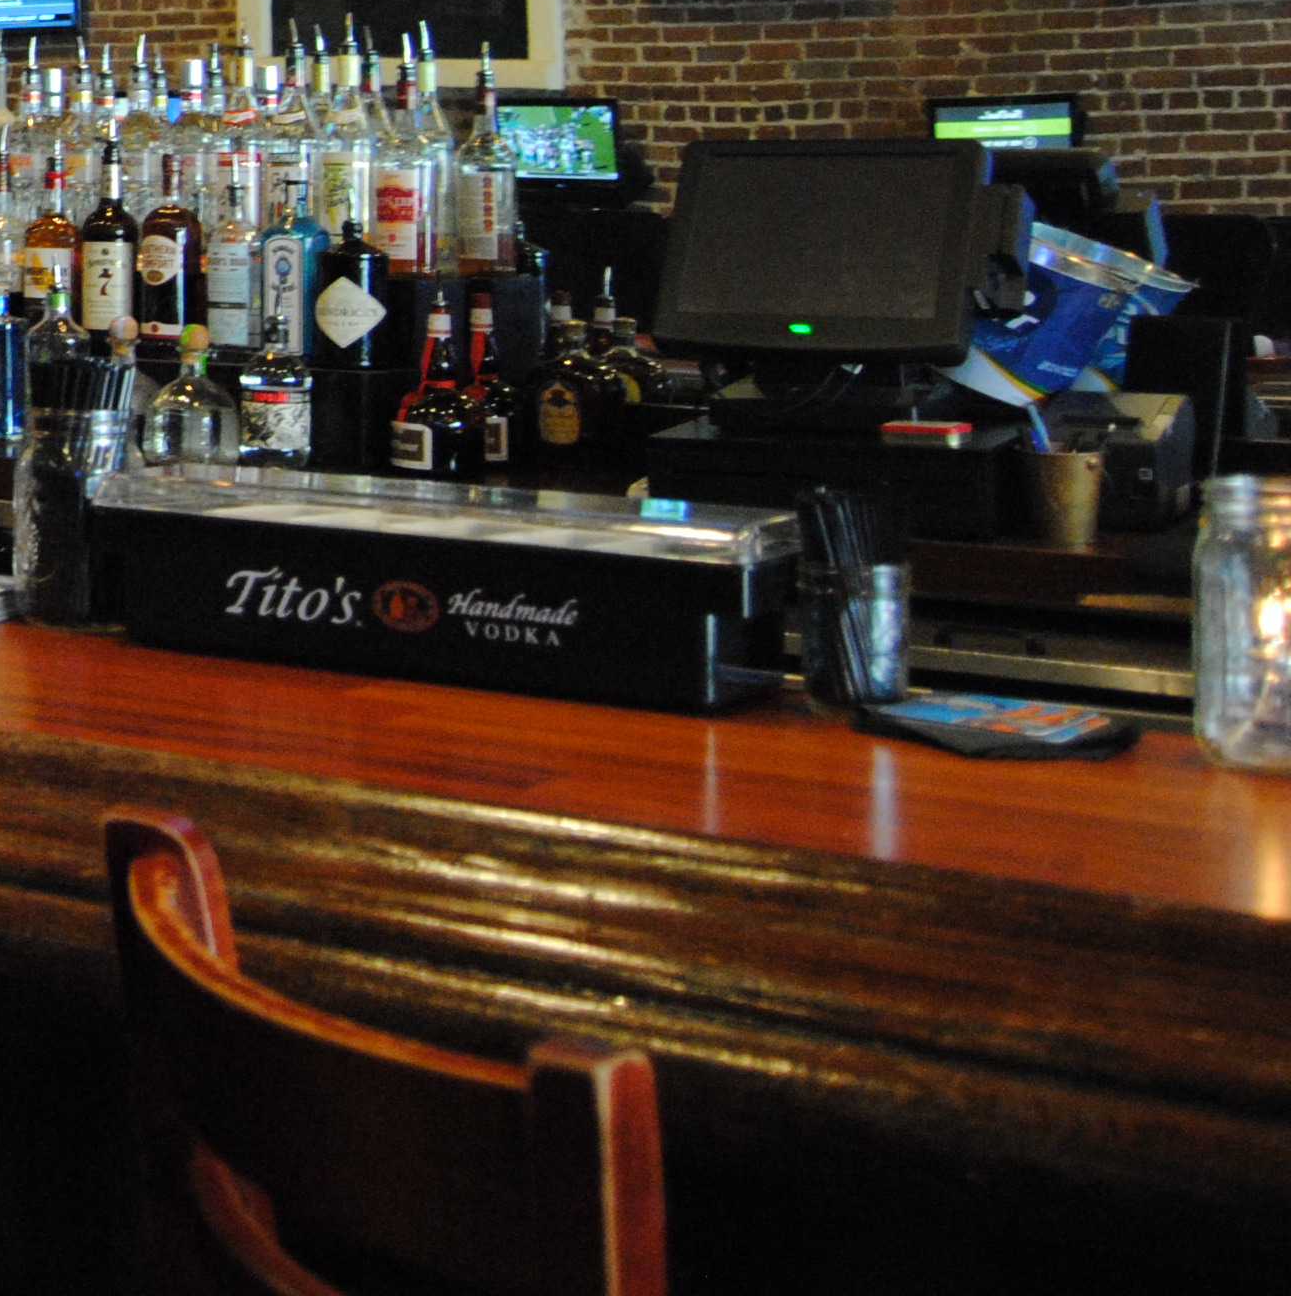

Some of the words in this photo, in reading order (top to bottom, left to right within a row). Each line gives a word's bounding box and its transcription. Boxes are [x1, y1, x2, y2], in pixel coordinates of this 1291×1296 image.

[98, 272, 114, 297] 7
[225, 566, 362, 626] Tito's
[446, 587, 580, 626] Handmade
[464, 620, 562, 647] VODKA
